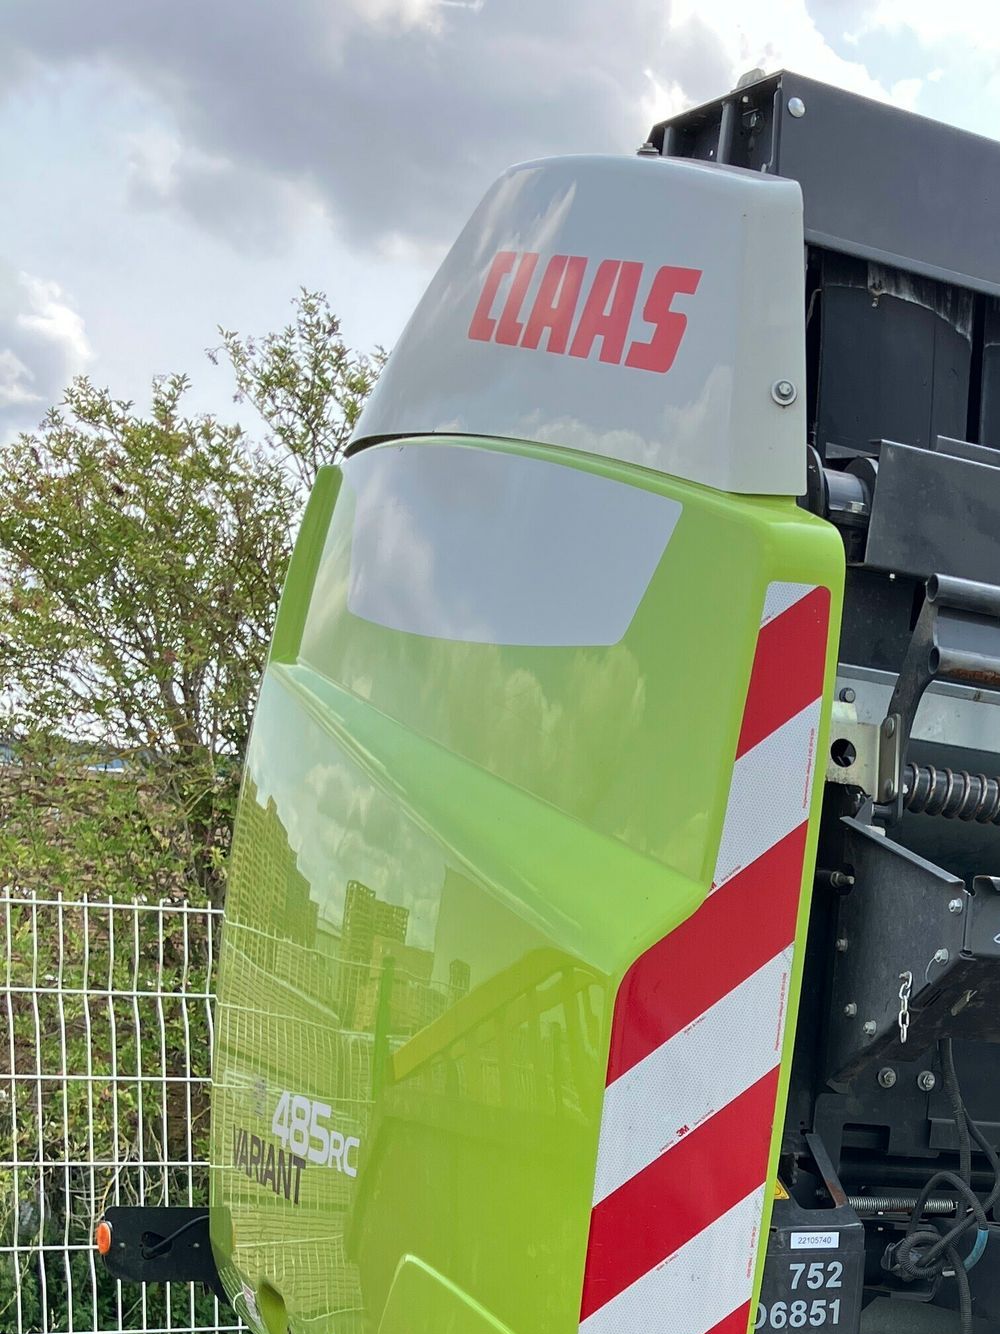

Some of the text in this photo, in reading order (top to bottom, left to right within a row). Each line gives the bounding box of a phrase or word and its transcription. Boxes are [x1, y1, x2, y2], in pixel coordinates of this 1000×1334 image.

[468, 250, 703, 374] CLAAS
[675, 1125, 690, 1138] 3M
[232, 1124, 306, 1205] VARIANT
[797, 1236, 832, 1245] 22105740
[789, 1261, 844, 1290] 752
